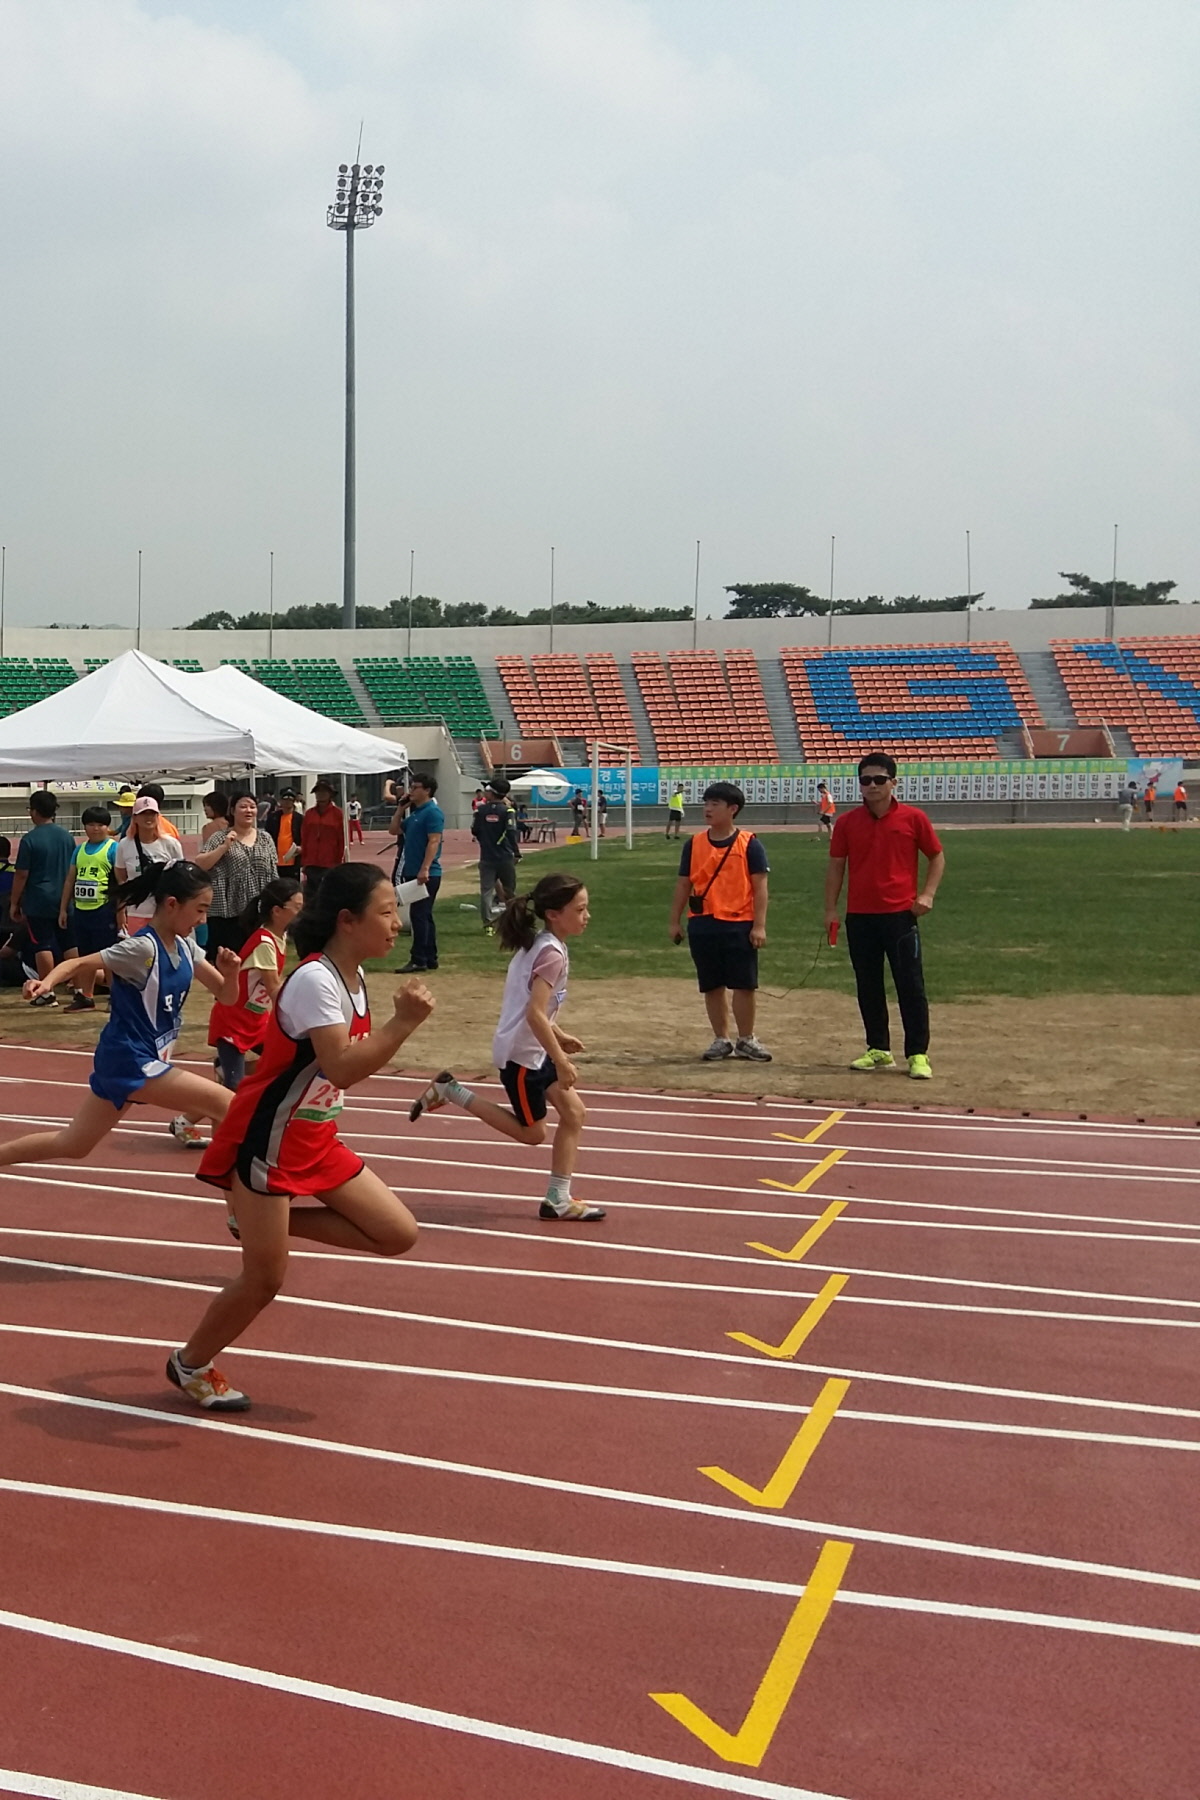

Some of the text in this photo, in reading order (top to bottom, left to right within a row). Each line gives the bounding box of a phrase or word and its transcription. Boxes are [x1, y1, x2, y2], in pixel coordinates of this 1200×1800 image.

[1057, 735, 1070, 751] 7
[511, 744, 522, 761] 6
[75, 886, 95, 897] 390
